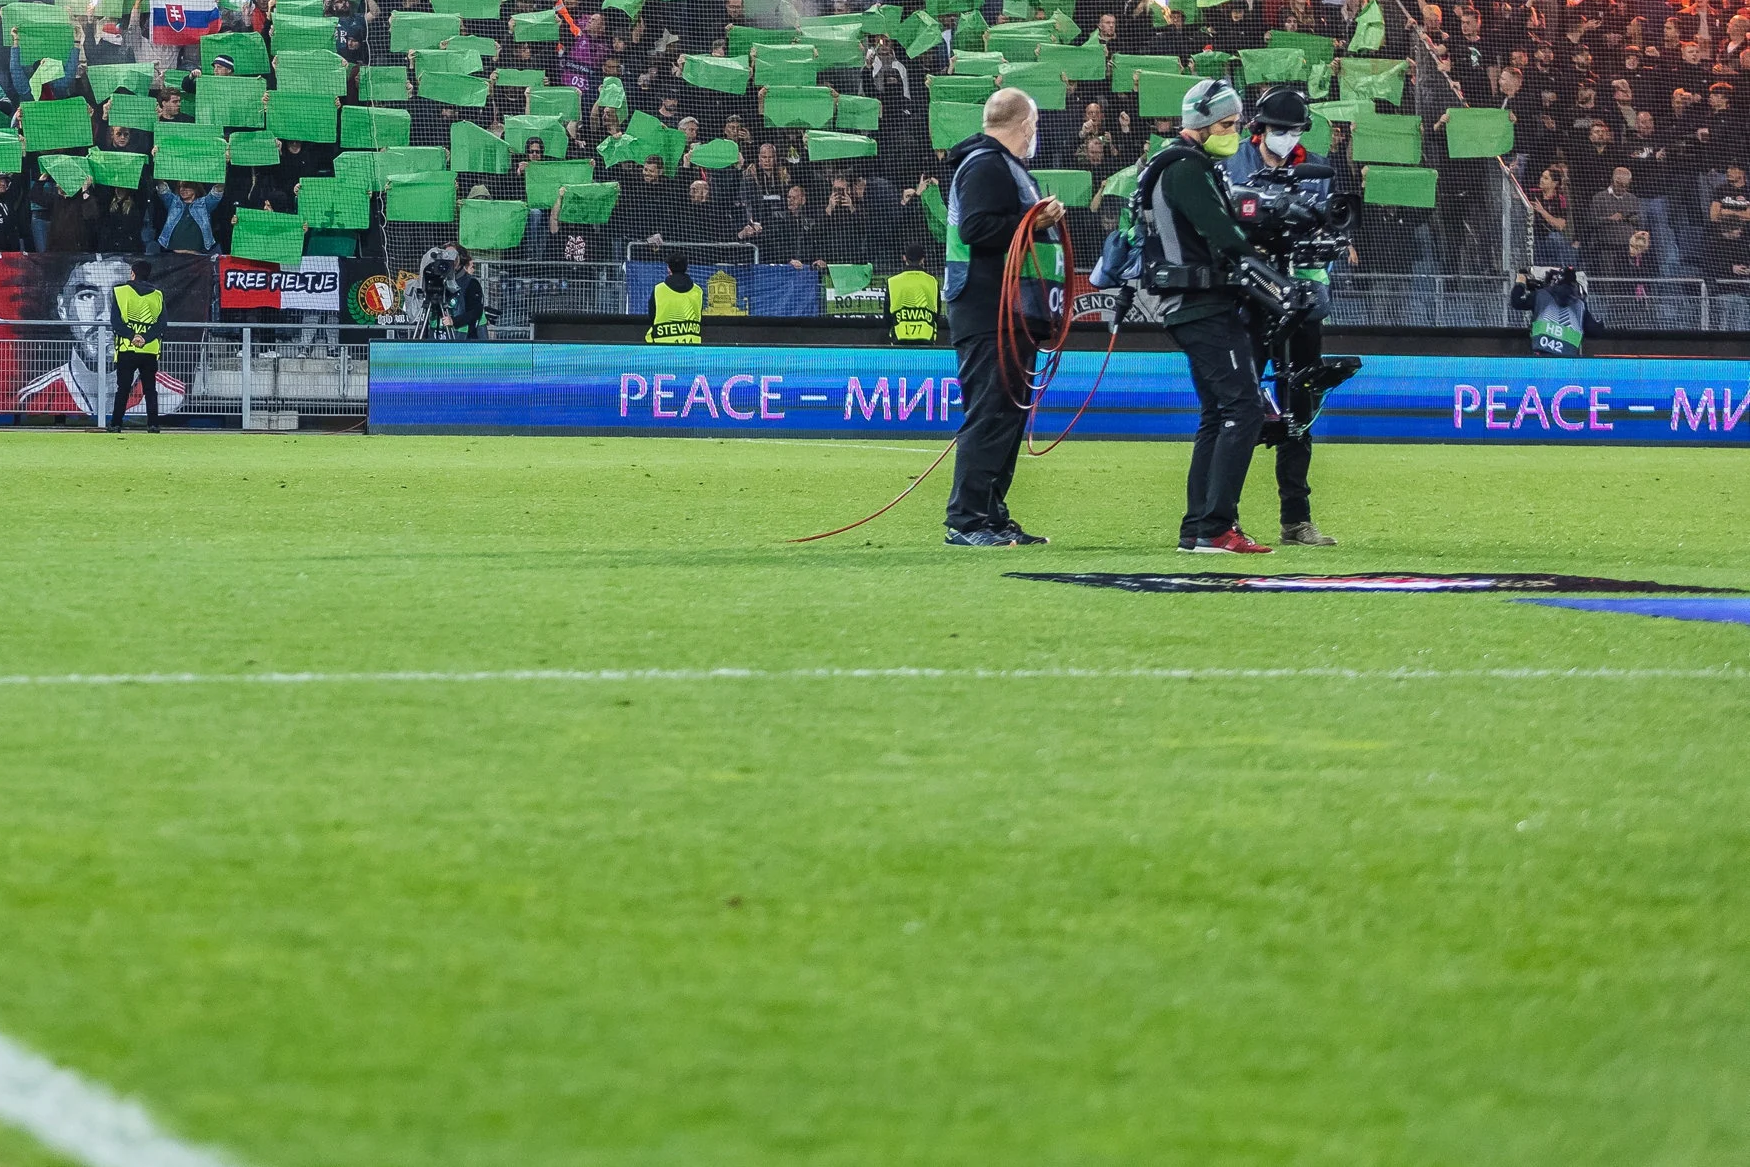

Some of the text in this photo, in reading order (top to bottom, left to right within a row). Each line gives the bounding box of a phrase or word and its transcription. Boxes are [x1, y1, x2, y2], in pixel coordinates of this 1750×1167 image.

[226, 271, 337, 291] FREE FIELTJE
[1545, 322, 1563, 337] HB
[1539, 336, 1564, 353] 042
[620, 373, 785, 420] PEACE
[1453, 384, 1614, 431] PEACE
